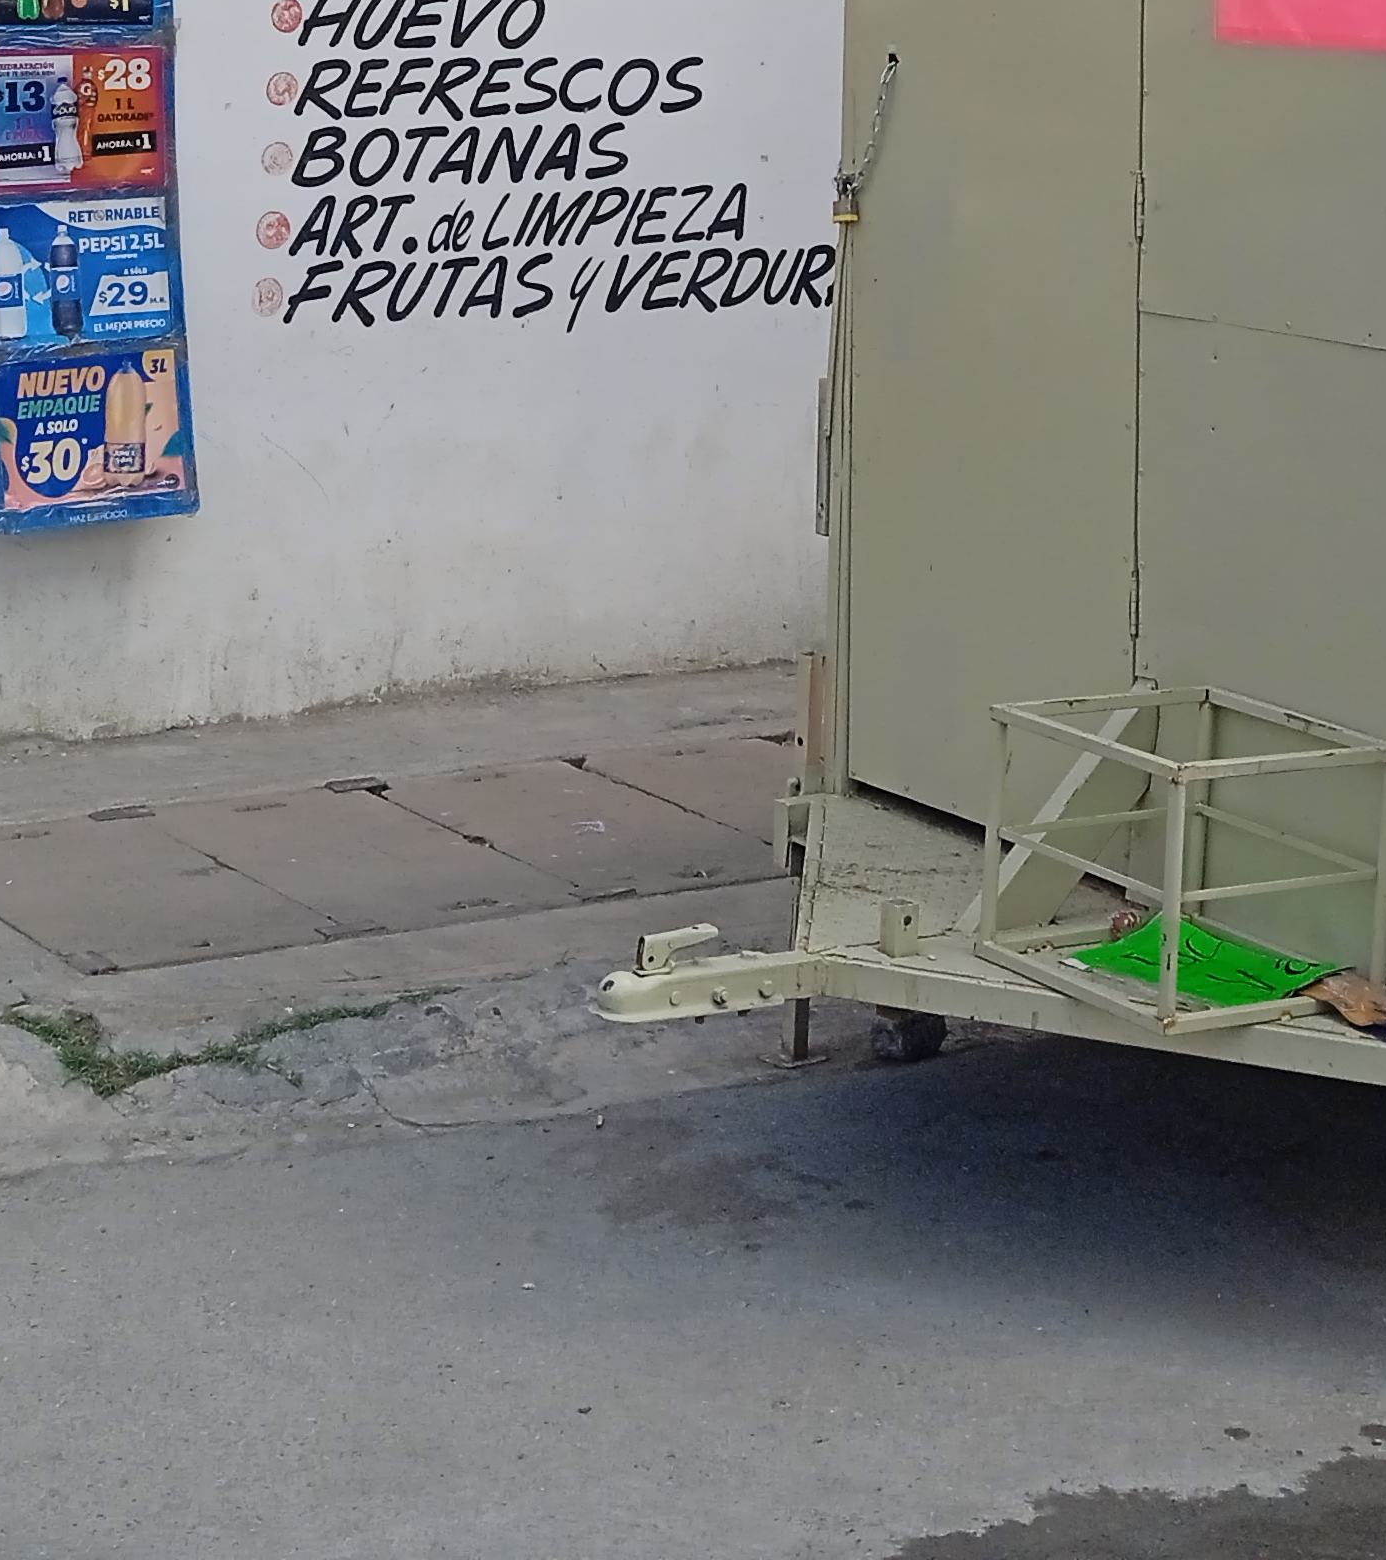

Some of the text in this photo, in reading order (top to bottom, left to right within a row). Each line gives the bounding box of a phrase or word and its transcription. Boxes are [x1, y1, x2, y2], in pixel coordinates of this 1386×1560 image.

[97, 57, 152, 91] $28
[293, 56, 705, 122] REFRESCOS
[290, 121, 630, 188] BOTANAS
[288, 182, 750, 260] ART. de LIMPIEZA
[98, 280, 149, 309] $29
[283, 252, 555, 327] FRUTAS
[604, 244, 836, 313] VERDUR
[93, 318, 166, 334] EL MEJOR PRECIO
[16, 358, 169, 400] NUEVO 3L
[16, 394, 102, 420] EMPAQUE
[34, 418, 79, 436] A SOLO
